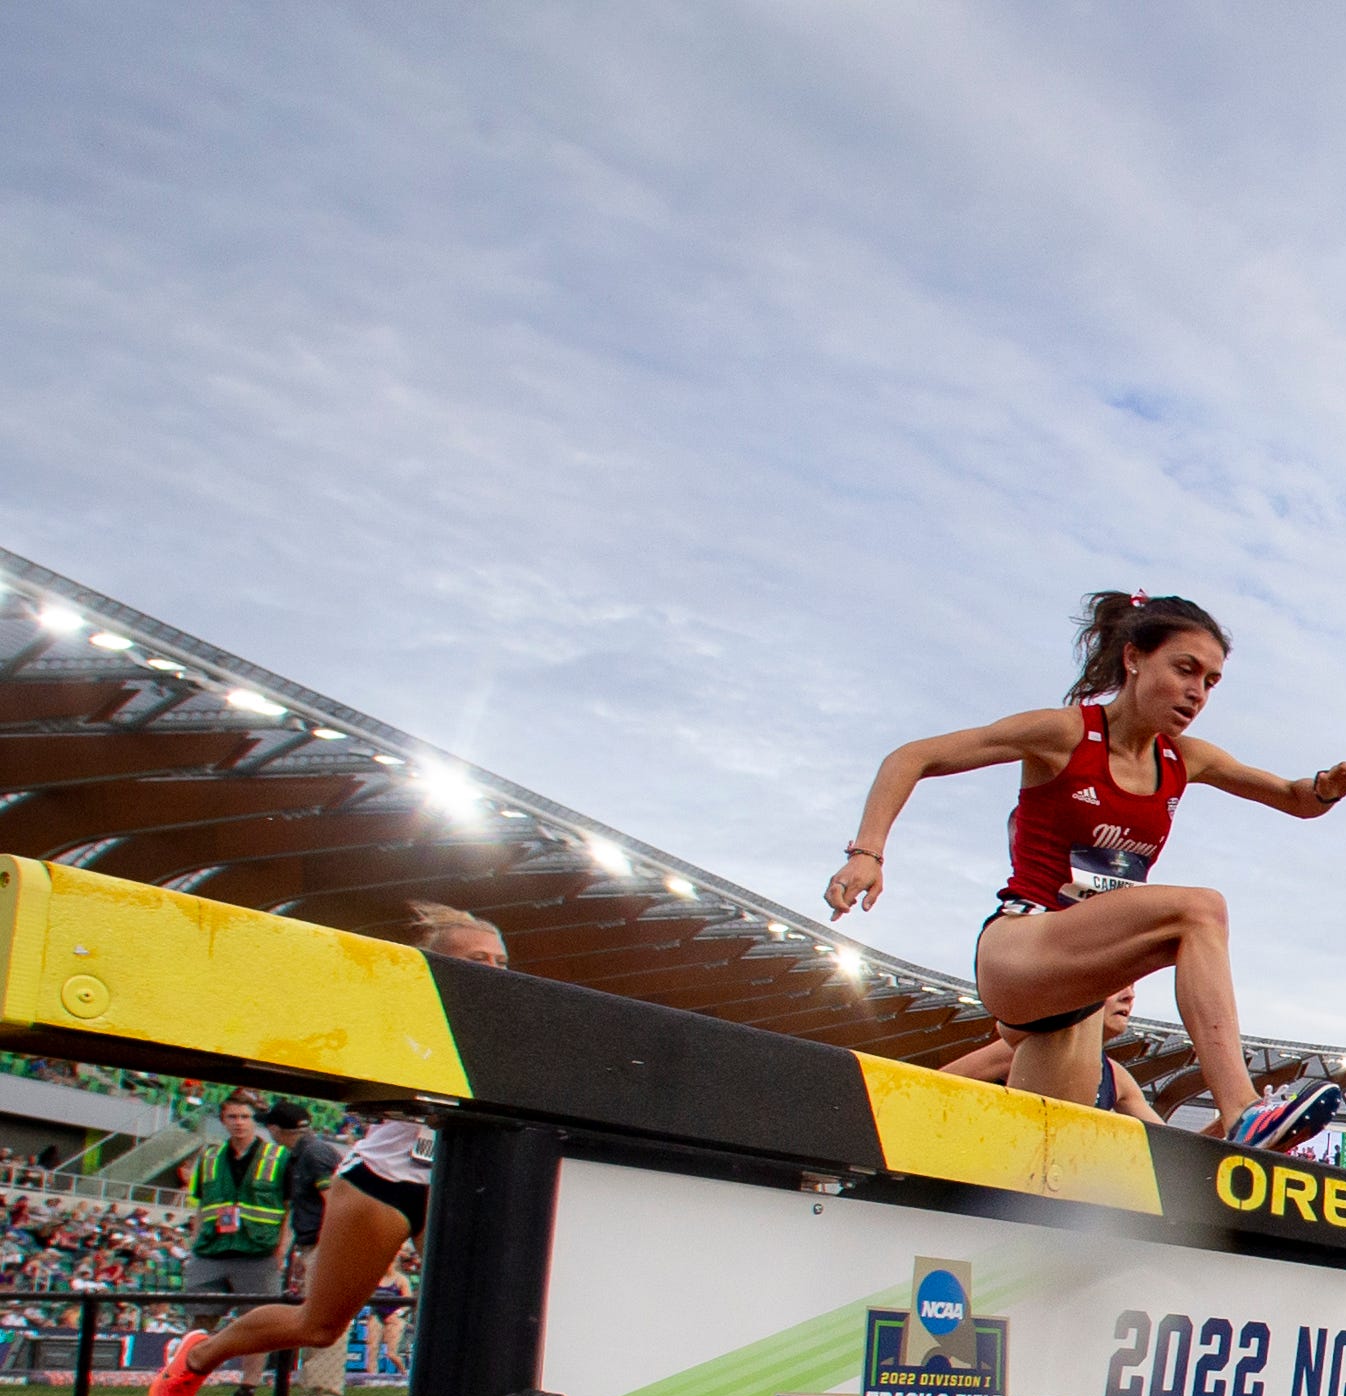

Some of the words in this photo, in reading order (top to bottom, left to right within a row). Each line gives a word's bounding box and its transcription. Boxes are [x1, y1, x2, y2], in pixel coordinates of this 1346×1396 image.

[1093, 875, 1135, 893] CARM
[921, 1300, 963, 1320] NCAA
[880, 1372, 916, 1386] 2022
[919, 1373, 981, 1388] DIVISION
[984, 1376, 992, 1388] I
